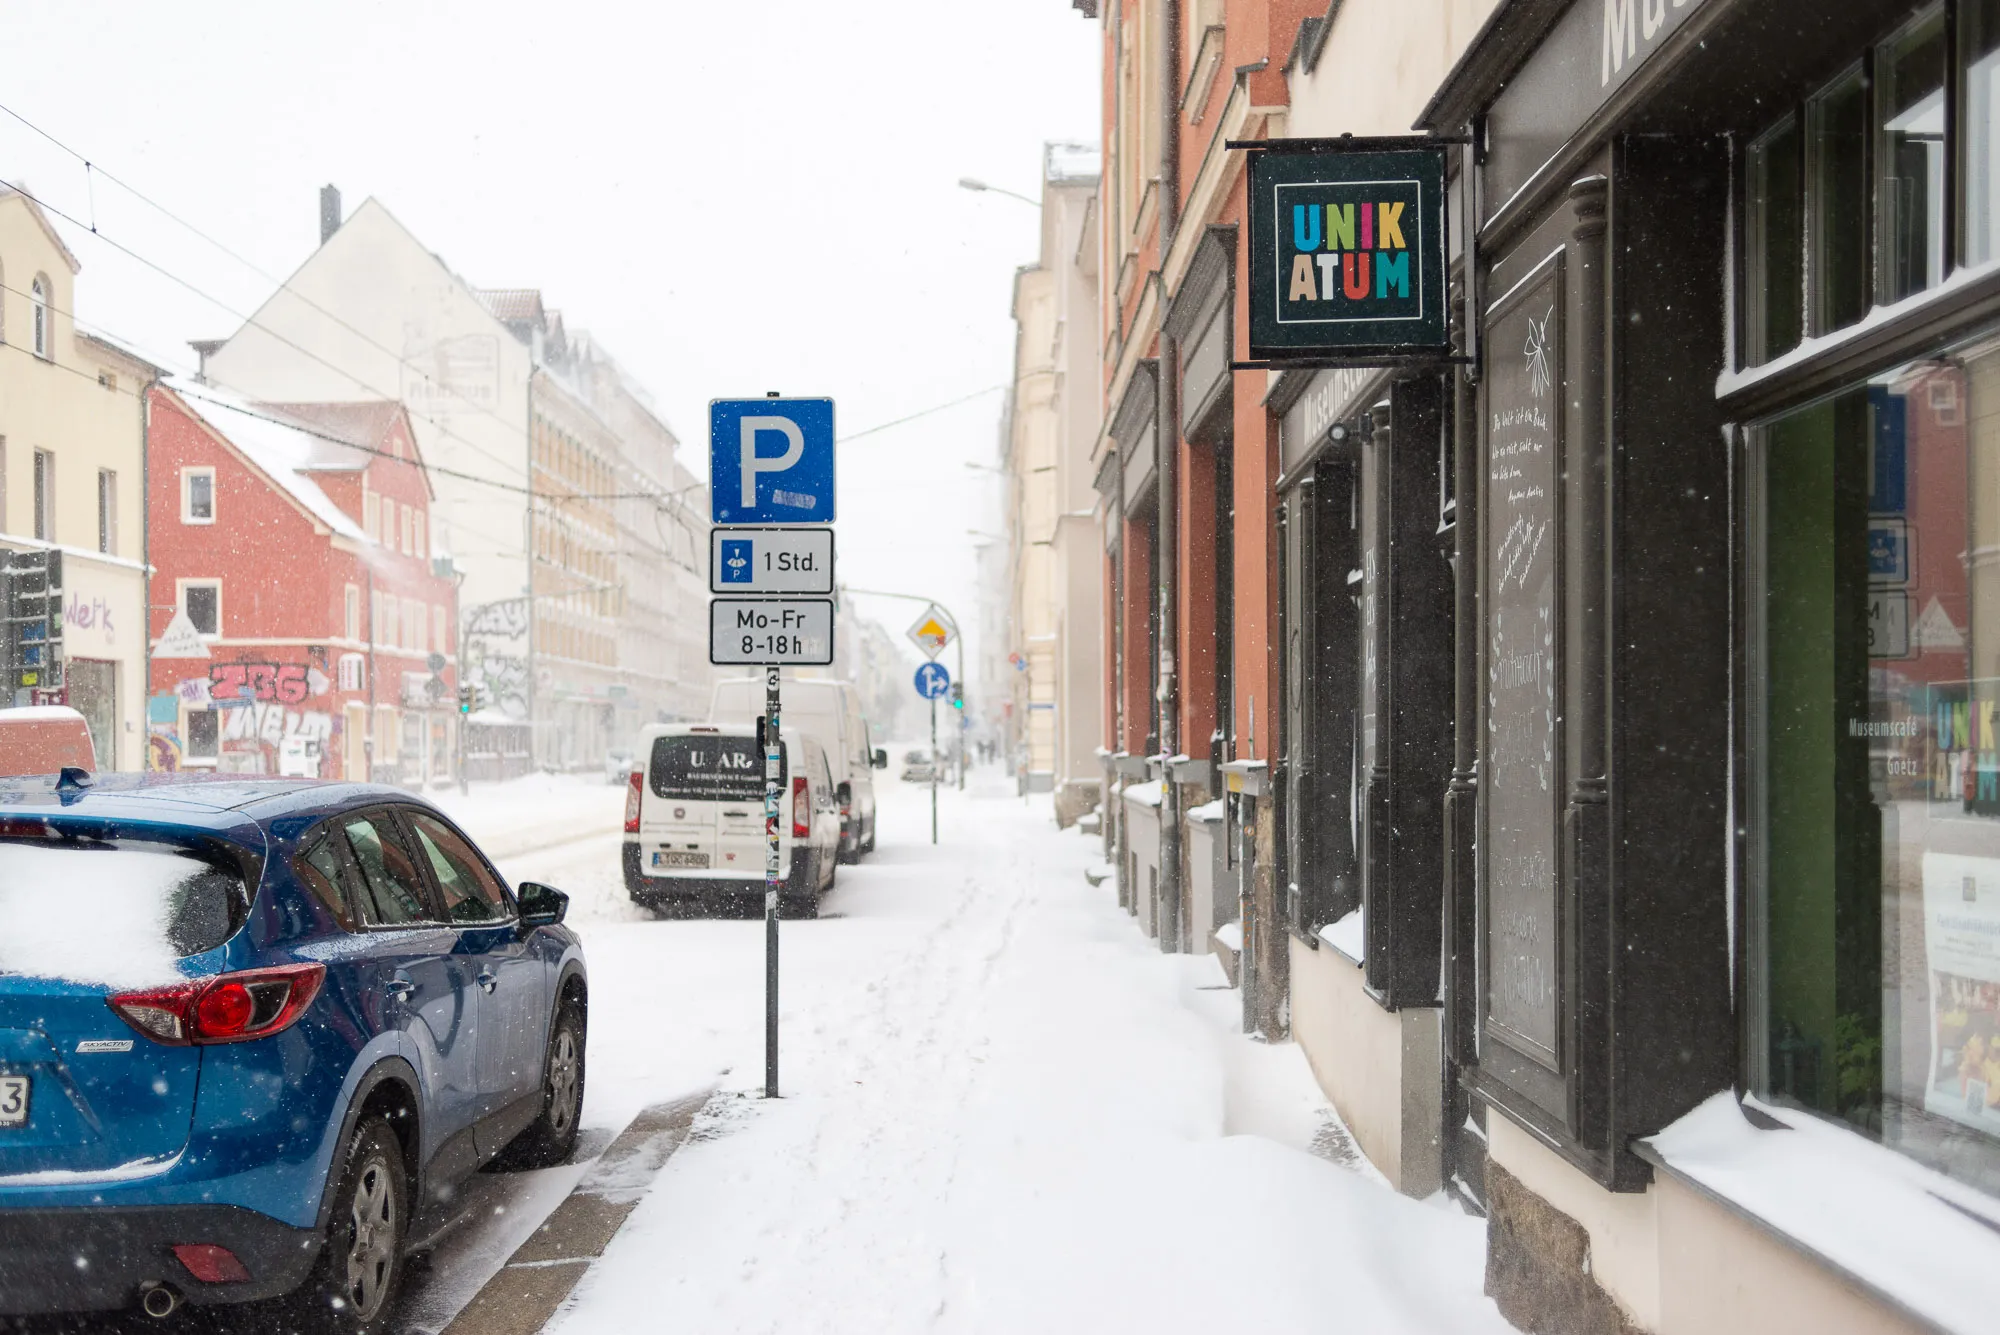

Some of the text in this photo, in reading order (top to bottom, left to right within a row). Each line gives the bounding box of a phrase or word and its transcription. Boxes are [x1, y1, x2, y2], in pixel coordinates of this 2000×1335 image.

[1292, 201, 1407, 252] UNIK
[1288, 251, 1410, 301] ATUM
[740, 415, 805, 508] P
[764, 552, 819, 572] 1 Std.
[733, 569, 741, 580] P
[737, 609, 806, 629] Mo-Fr
[741, 635, 802, 655] 8-18 h
[1849, 716, 1917, 737] Museumscafé
[1937, 700, 1995, 750] UNIK
[1887, 757, 1917, 776] Goetz
